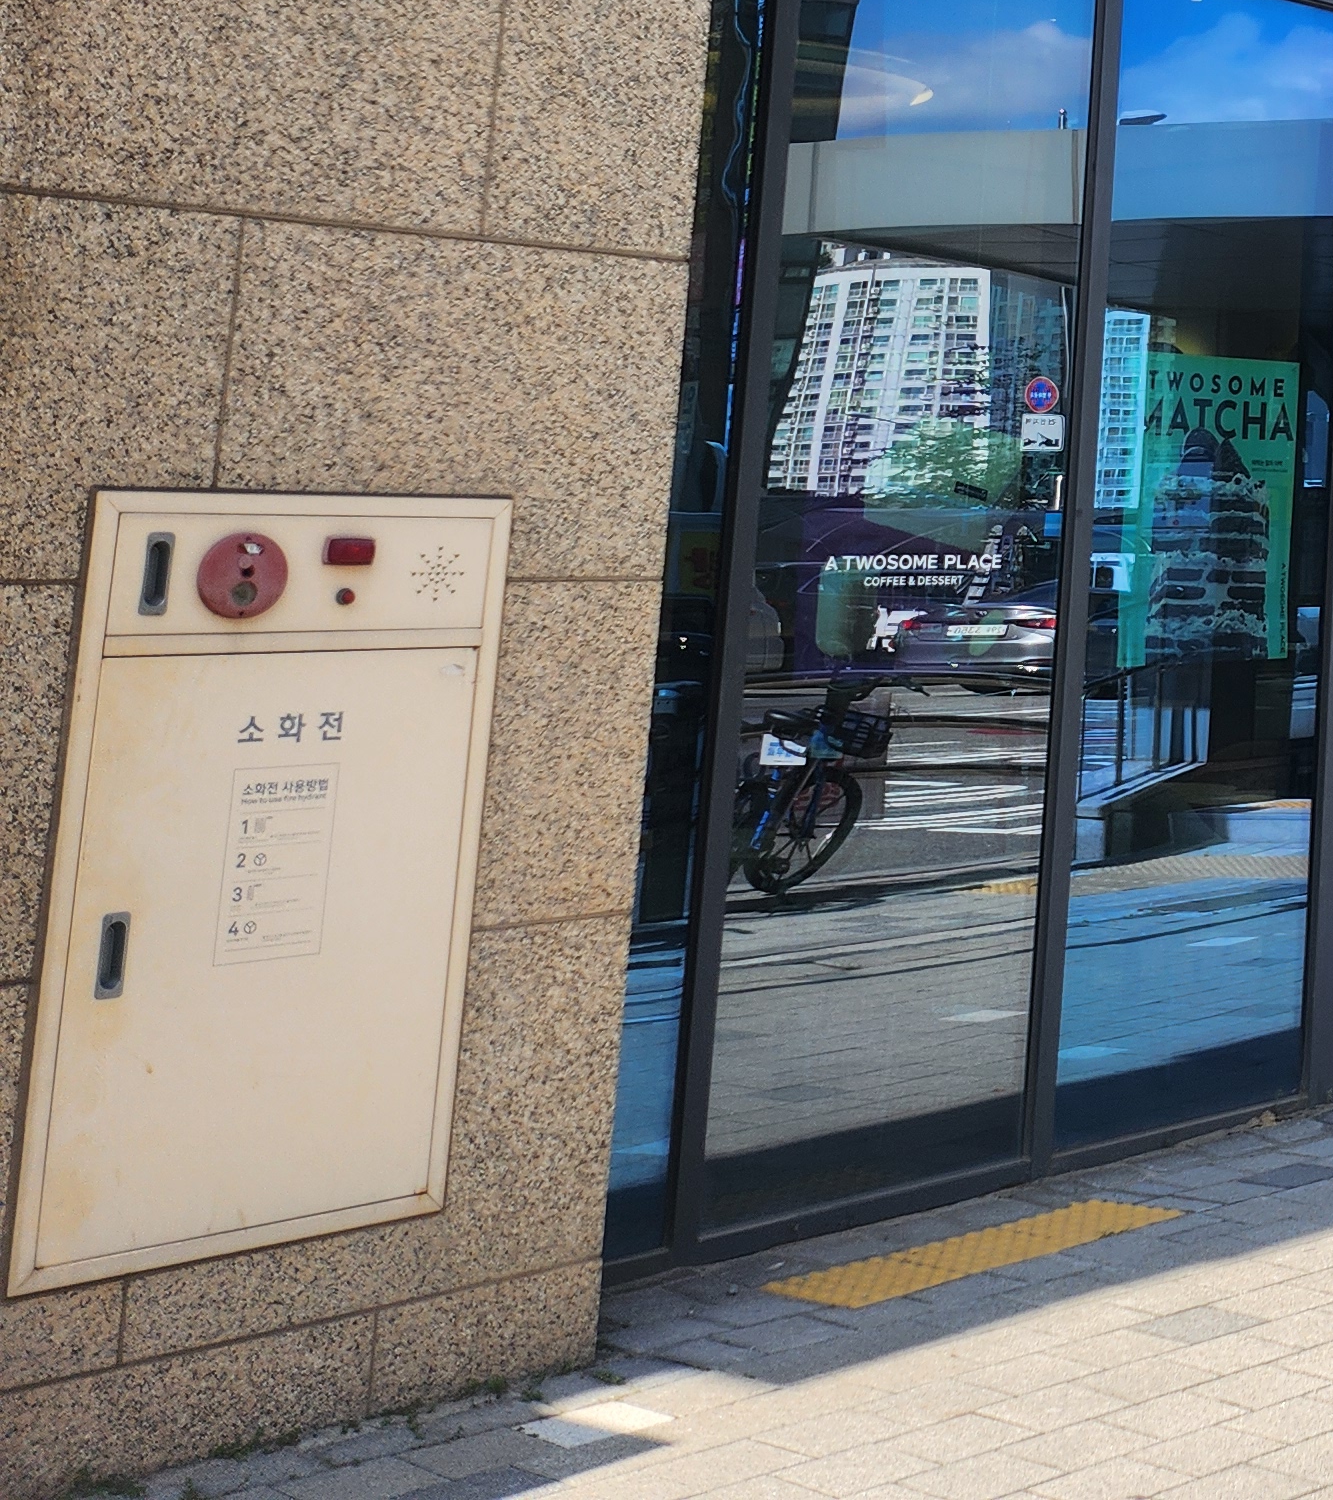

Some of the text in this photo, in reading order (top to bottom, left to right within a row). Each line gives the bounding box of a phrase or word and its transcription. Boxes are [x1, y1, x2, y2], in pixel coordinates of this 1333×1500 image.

[1149, 370, 1285, 398] TWOSOME
[825, 554, 1003, 571] A TWOSOME PLACE
[864, 576, 906, 587] COFFEE
[917, 575, 964, 586] DESSERT
[242, 778, 329, 795] 소화전 사용방법
[241, 819, 249, 835] 1
[236, 852, 247, 868] 2
[232, 886, 243, 902] 3
[228, 921, 239, 936] 4
